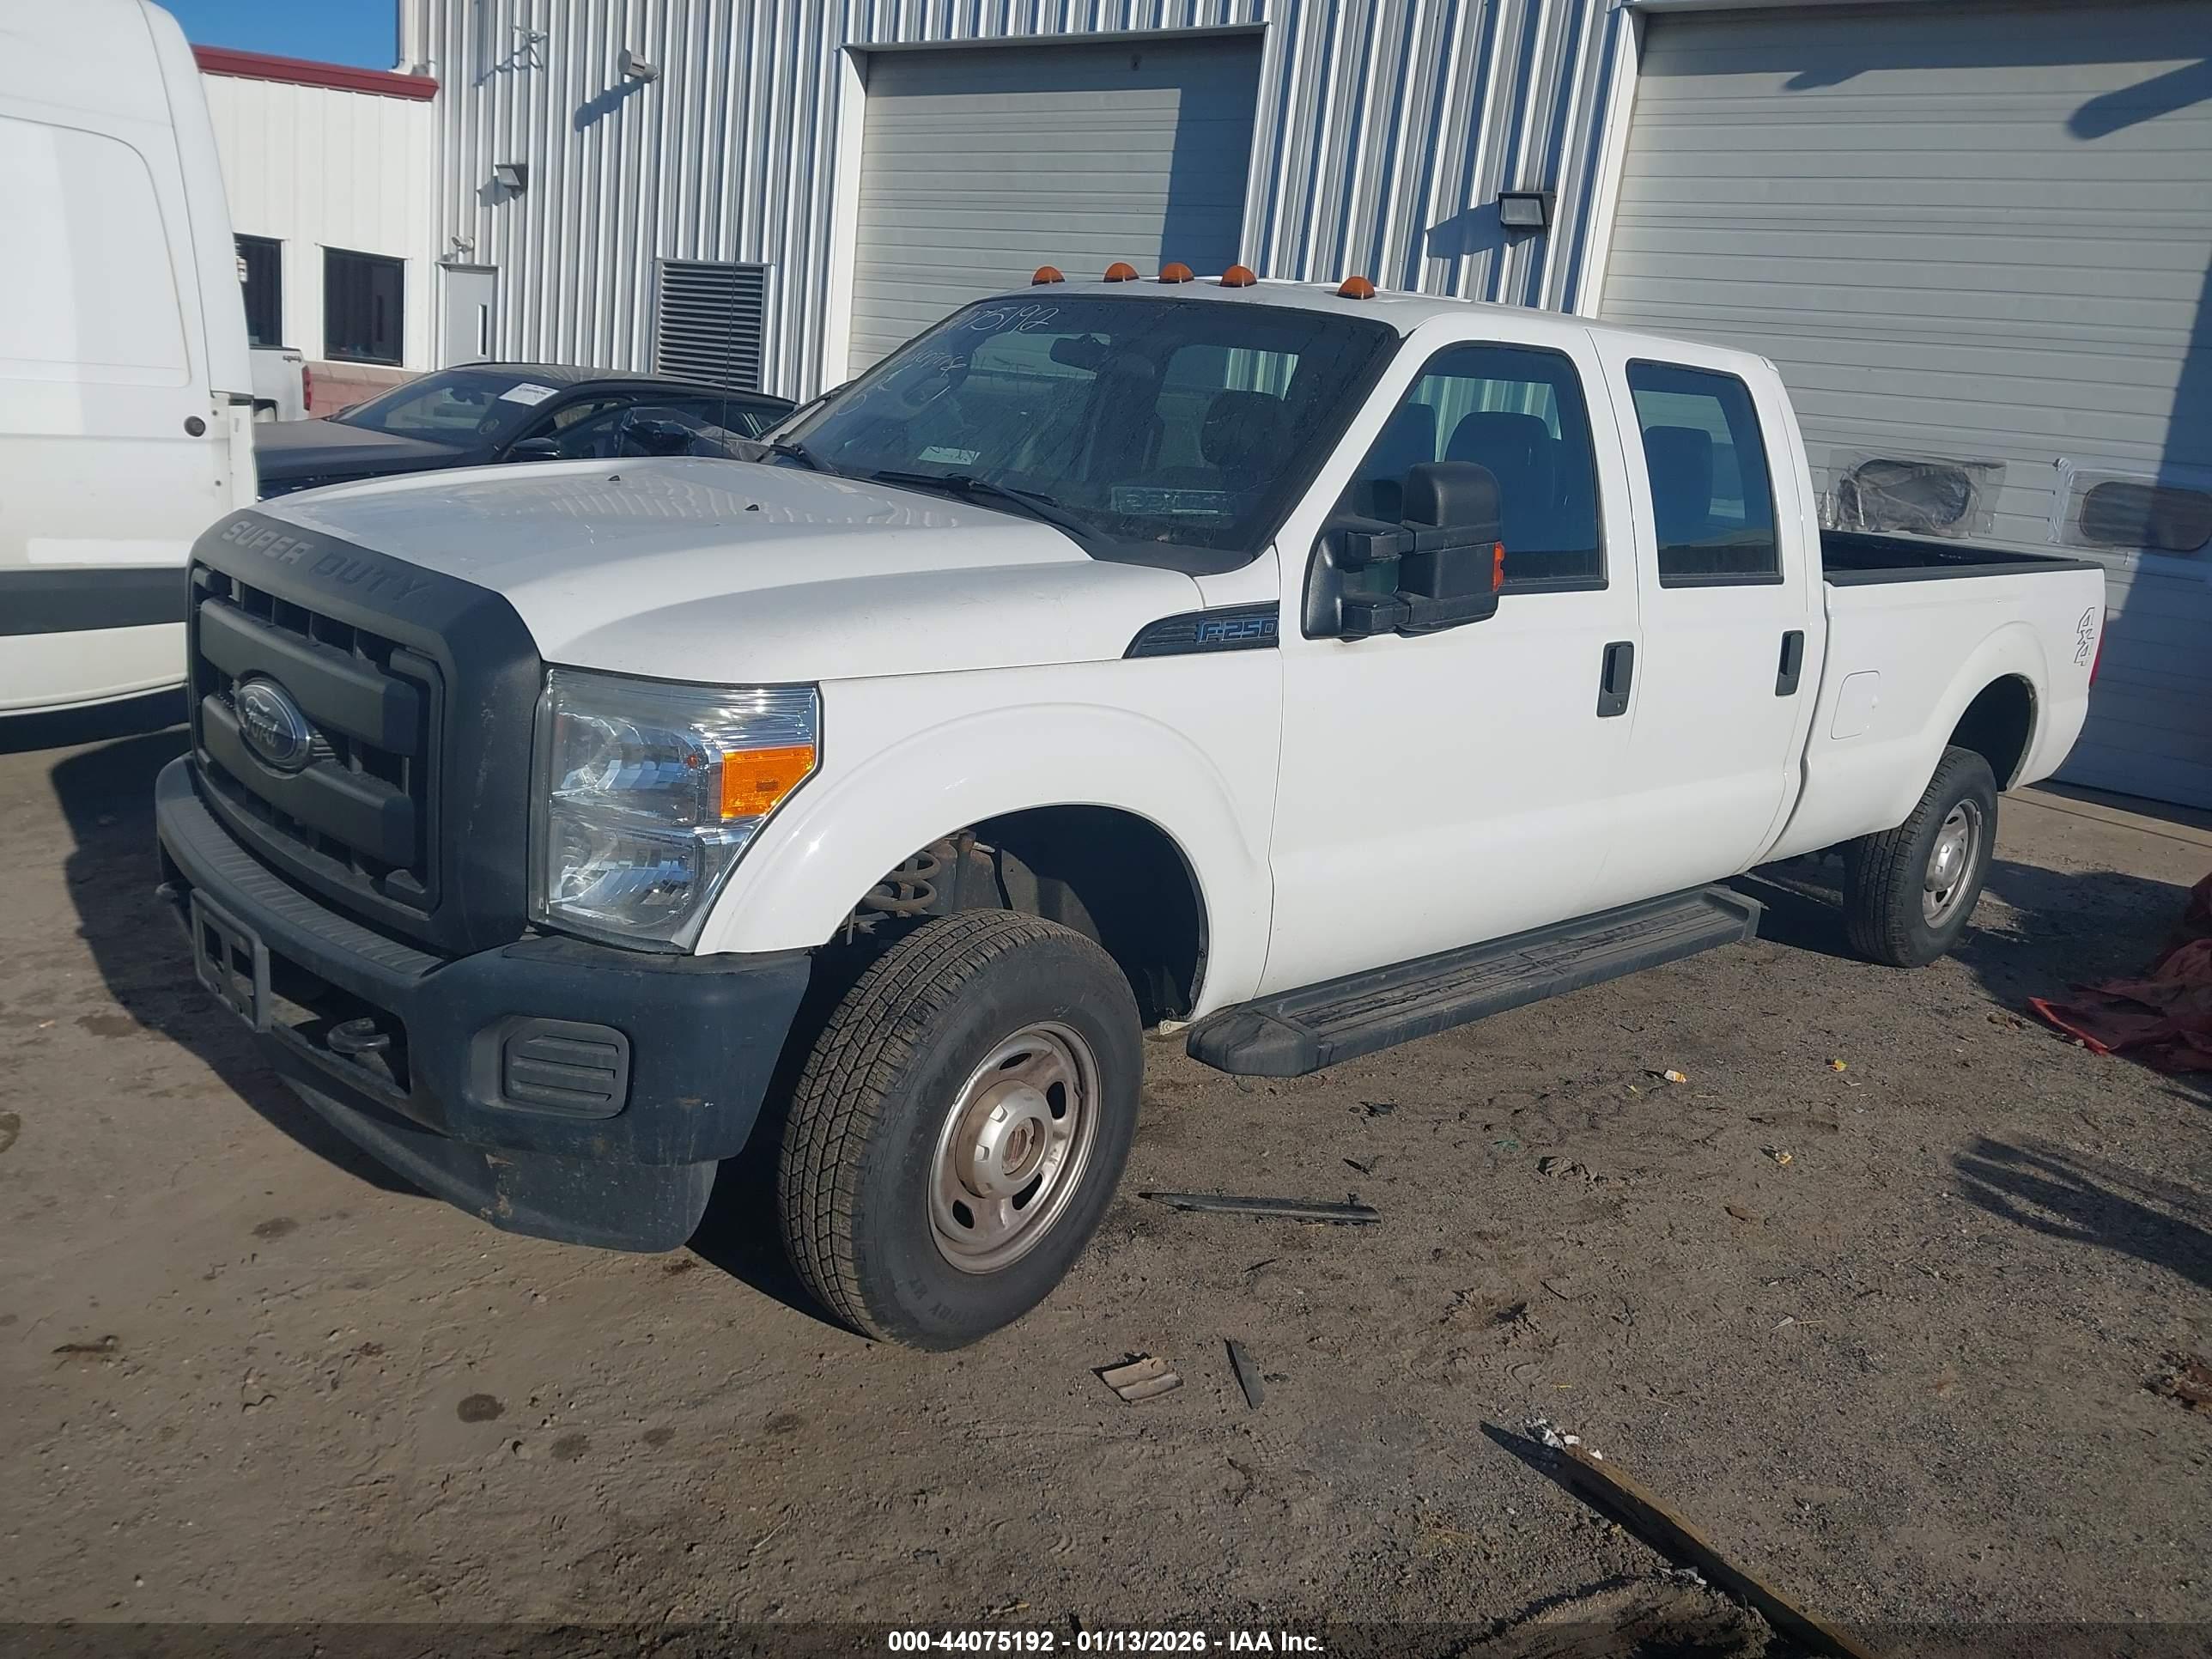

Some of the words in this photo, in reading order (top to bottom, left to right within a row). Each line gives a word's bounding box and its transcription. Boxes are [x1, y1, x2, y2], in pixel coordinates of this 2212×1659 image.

[221, 520, 315, 565] SUPER
[309, 552, 434, 604] DUTY
[1198, 617, 1279, 645] F-250
[245, 695, 280, 748] Ford
